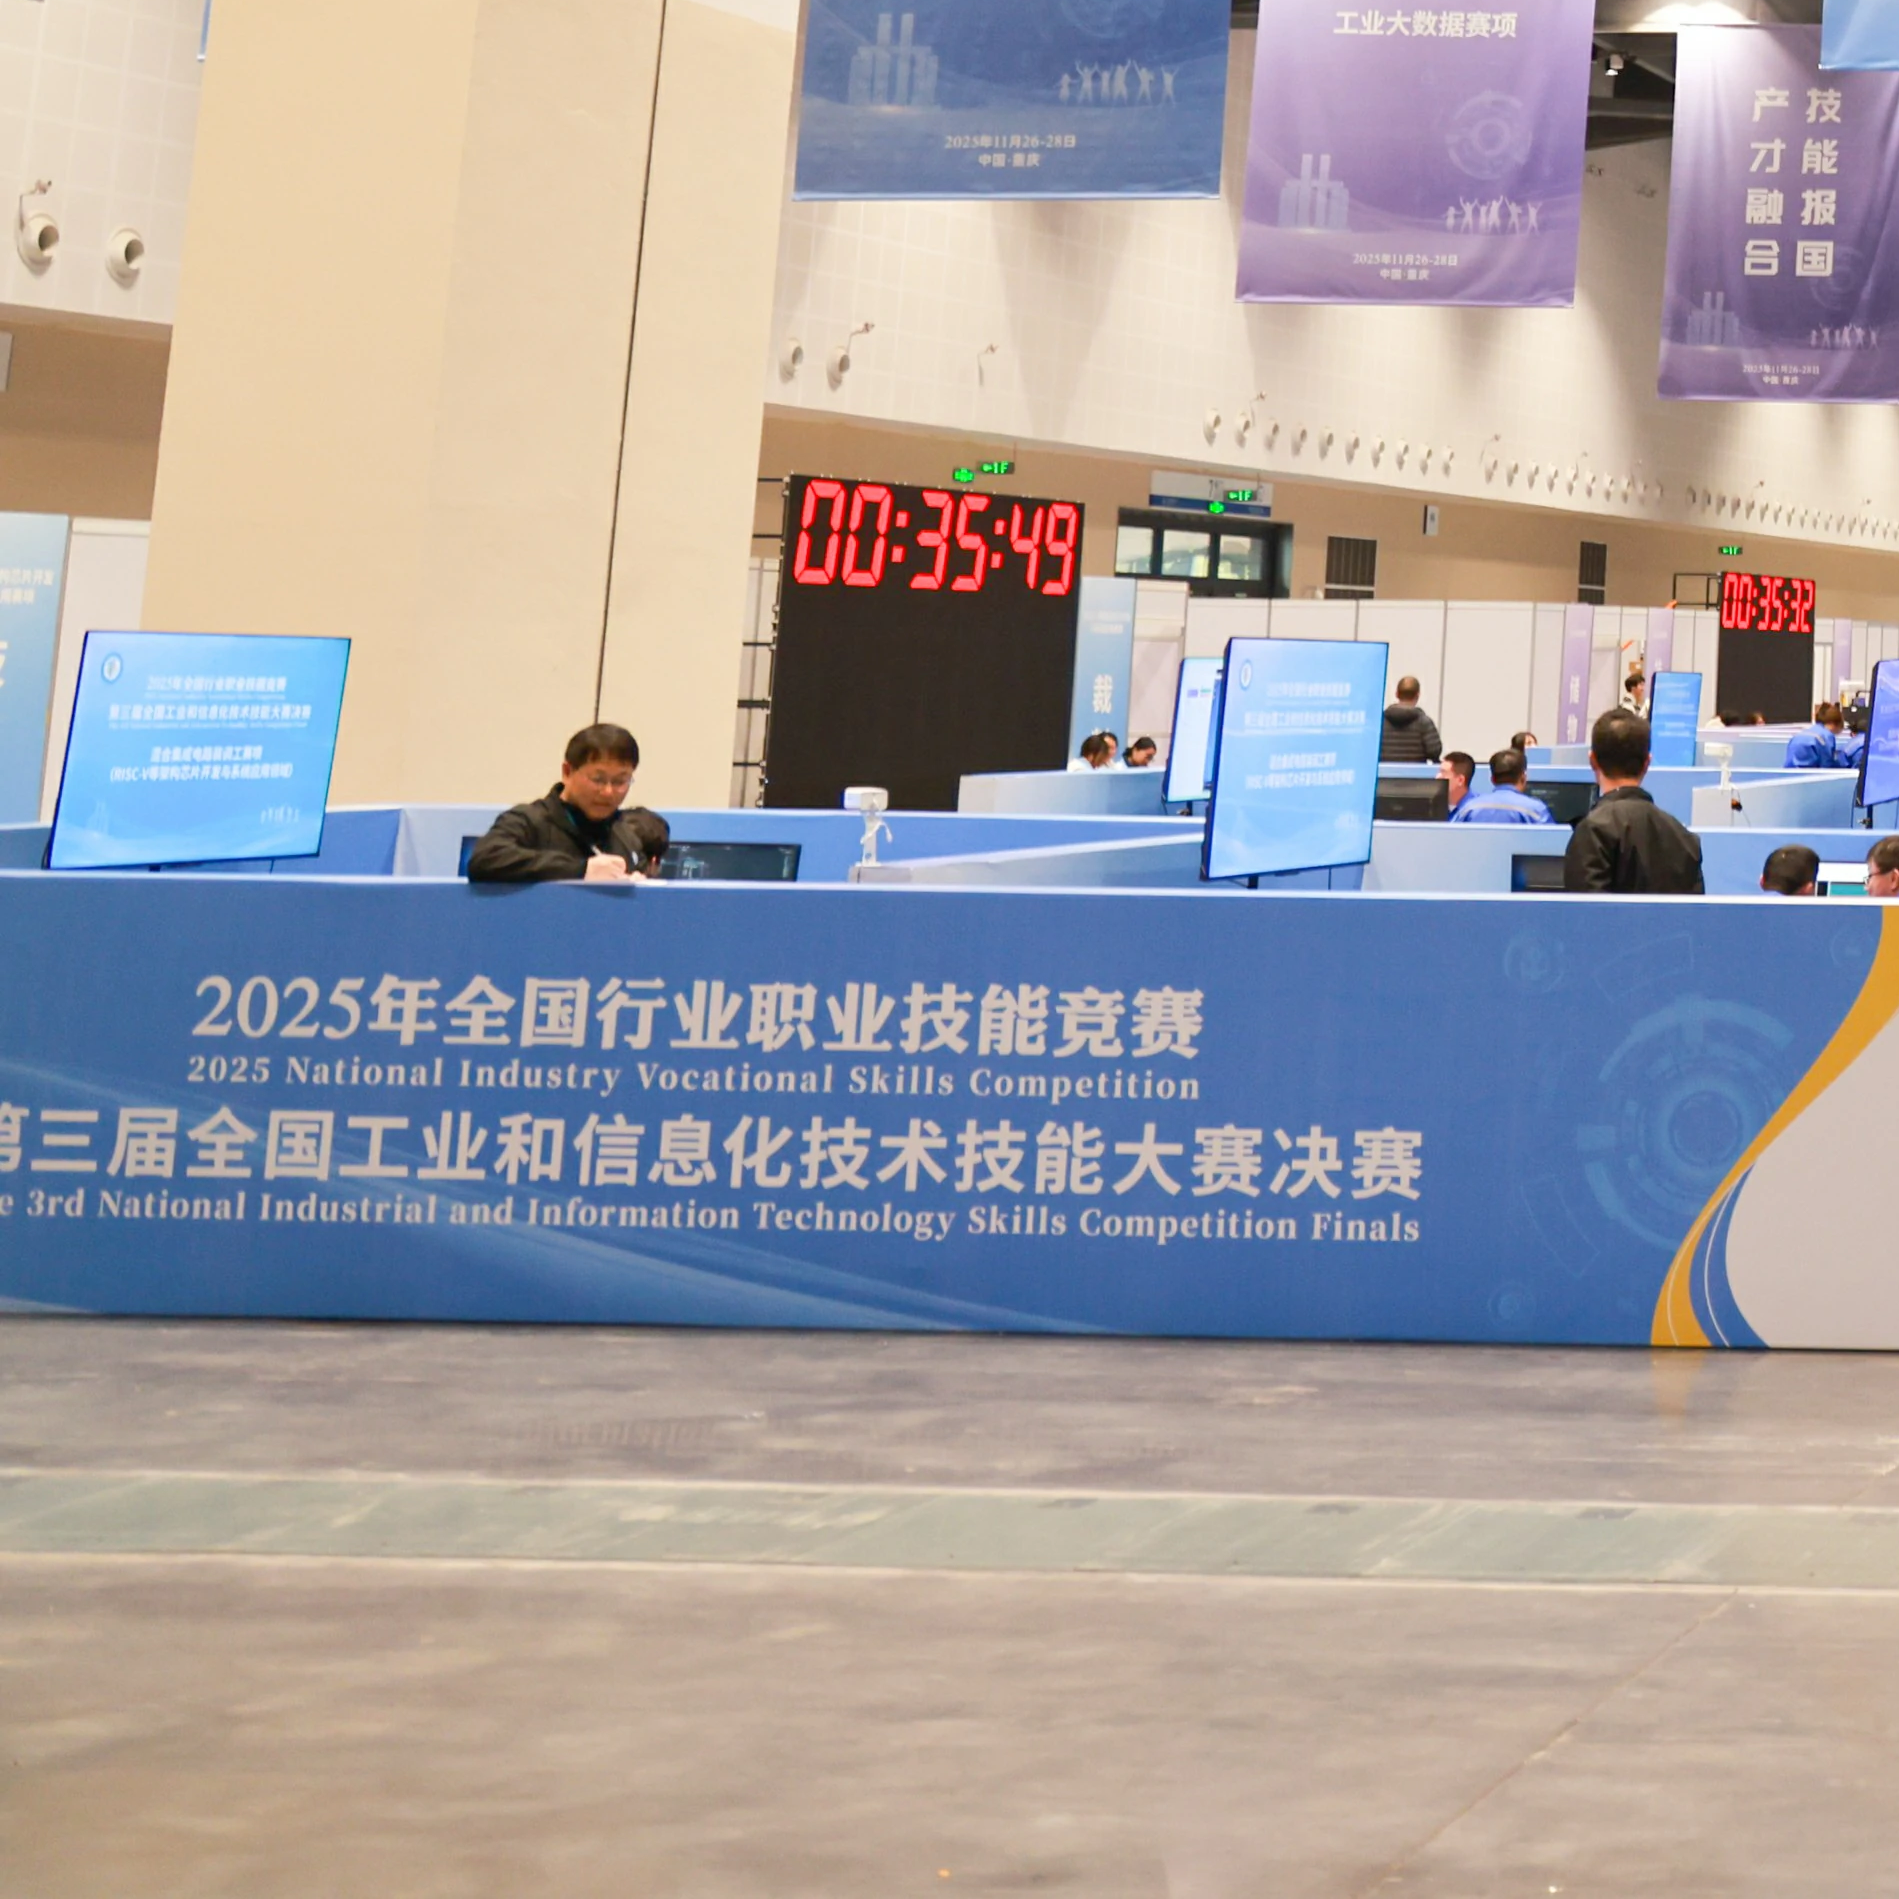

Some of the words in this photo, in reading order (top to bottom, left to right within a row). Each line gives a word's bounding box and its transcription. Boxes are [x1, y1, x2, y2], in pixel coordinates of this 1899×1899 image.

[1333, 9, 1518, 39] 工业大数据赛项
[1743, 86, 1790, 278] 产才融合
[1795, 85, 1842, 278] 技能报国
[793, 478, 1080, 596] 00:35:49
[1720, 571, 1815, 634] 00:35:32
[192, 972, 1205, 1061] 2025年全国行业职业技能竞赛
[187, 1055, 271, 1084] 2025
[284, 1057, 444, 1088] National
[459, 1058, 622, 1098] Industry
[636, 1061, 834, 1094] Vocational
[848, 1063, 954, 1096] Skills
[969, 1067, 1200, 1106] Competition
[26, 1187, 86, 1218] 3rd
[97, 1188, 246, 1222] National
[258, 1191, 437, 1225] Industrial
[449, 1196, 513, 1227] and
[527, 1195, 740, 1231] Information
[753, 1201, 957, 1242] Technology
[967, 1205, 1068, 1237] Skills
[1079, 1208, 1299, 1246] Competition
[1311, 1211, 1421, 1244] Finals
